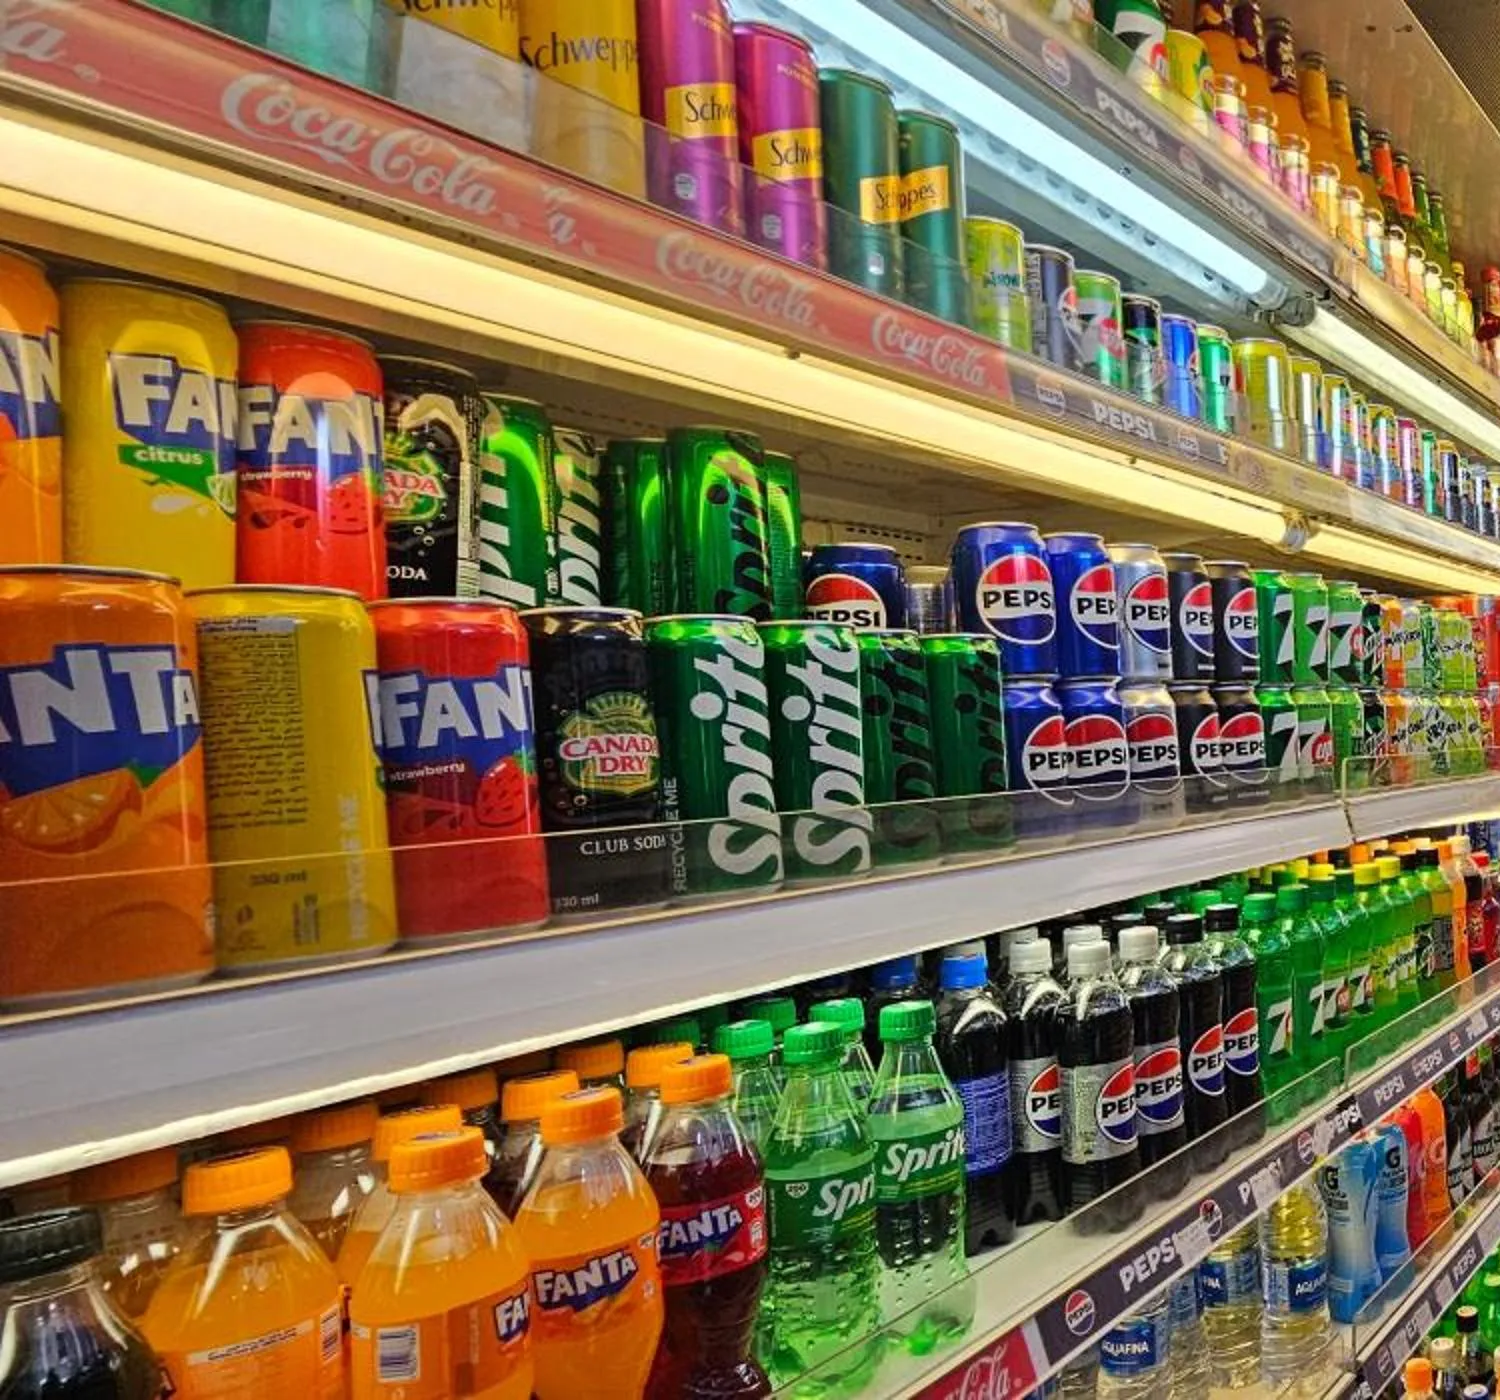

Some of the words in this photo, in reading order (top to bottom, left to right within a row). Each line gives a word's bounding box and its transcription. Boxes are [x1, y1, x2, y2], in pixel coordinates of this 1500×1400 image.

[1093, 401, 1157, 441] PEPSI
[134, 446, 204, 466] citrus
[389, 762, 465, 782] strawberry
[600, 756, 646, 774] DRY
[580, 838, 629, 855] CLUB
[1373, 1073, 1406, 1106] PEPSI
[1385, 1147, 1401, 1169] G
[1323, 1165, 1340, 1191] G
[659, 1203, 744, 1250] FANTA
[535, 1250, 638, 1305] FANTA
